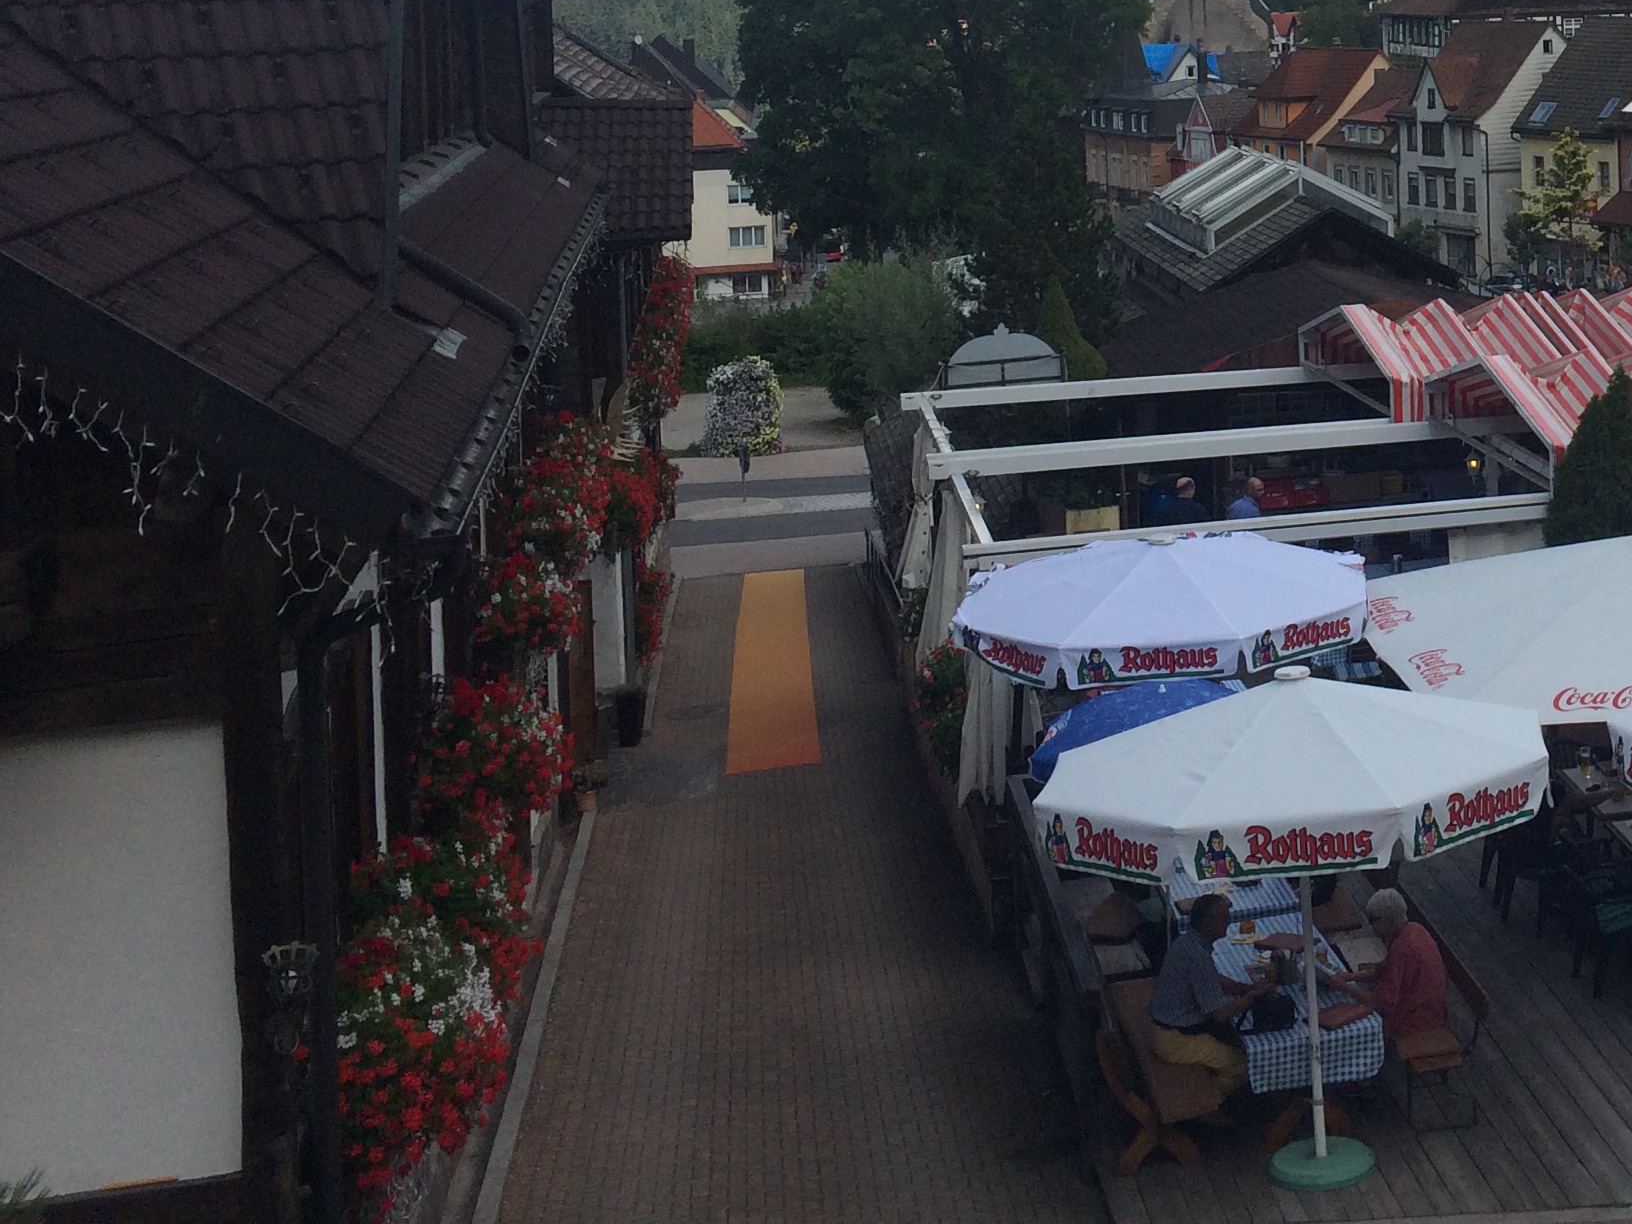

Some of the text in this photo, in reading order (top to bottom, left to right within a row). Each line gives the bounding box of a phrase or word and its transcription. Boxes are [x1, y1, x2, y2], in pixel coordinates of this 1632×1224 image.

[1281, 616, 1351, 652] Rothaus
[1118, 645, 1218, 674] Rothaus
[1408, 648, 1465, 691] Coca-Cola
[1444, 781, 1530, 833] Rothaus
[1075, 817, 1159, 872] Rothaus
[1243, 826, 1373, 868] Rothaus
